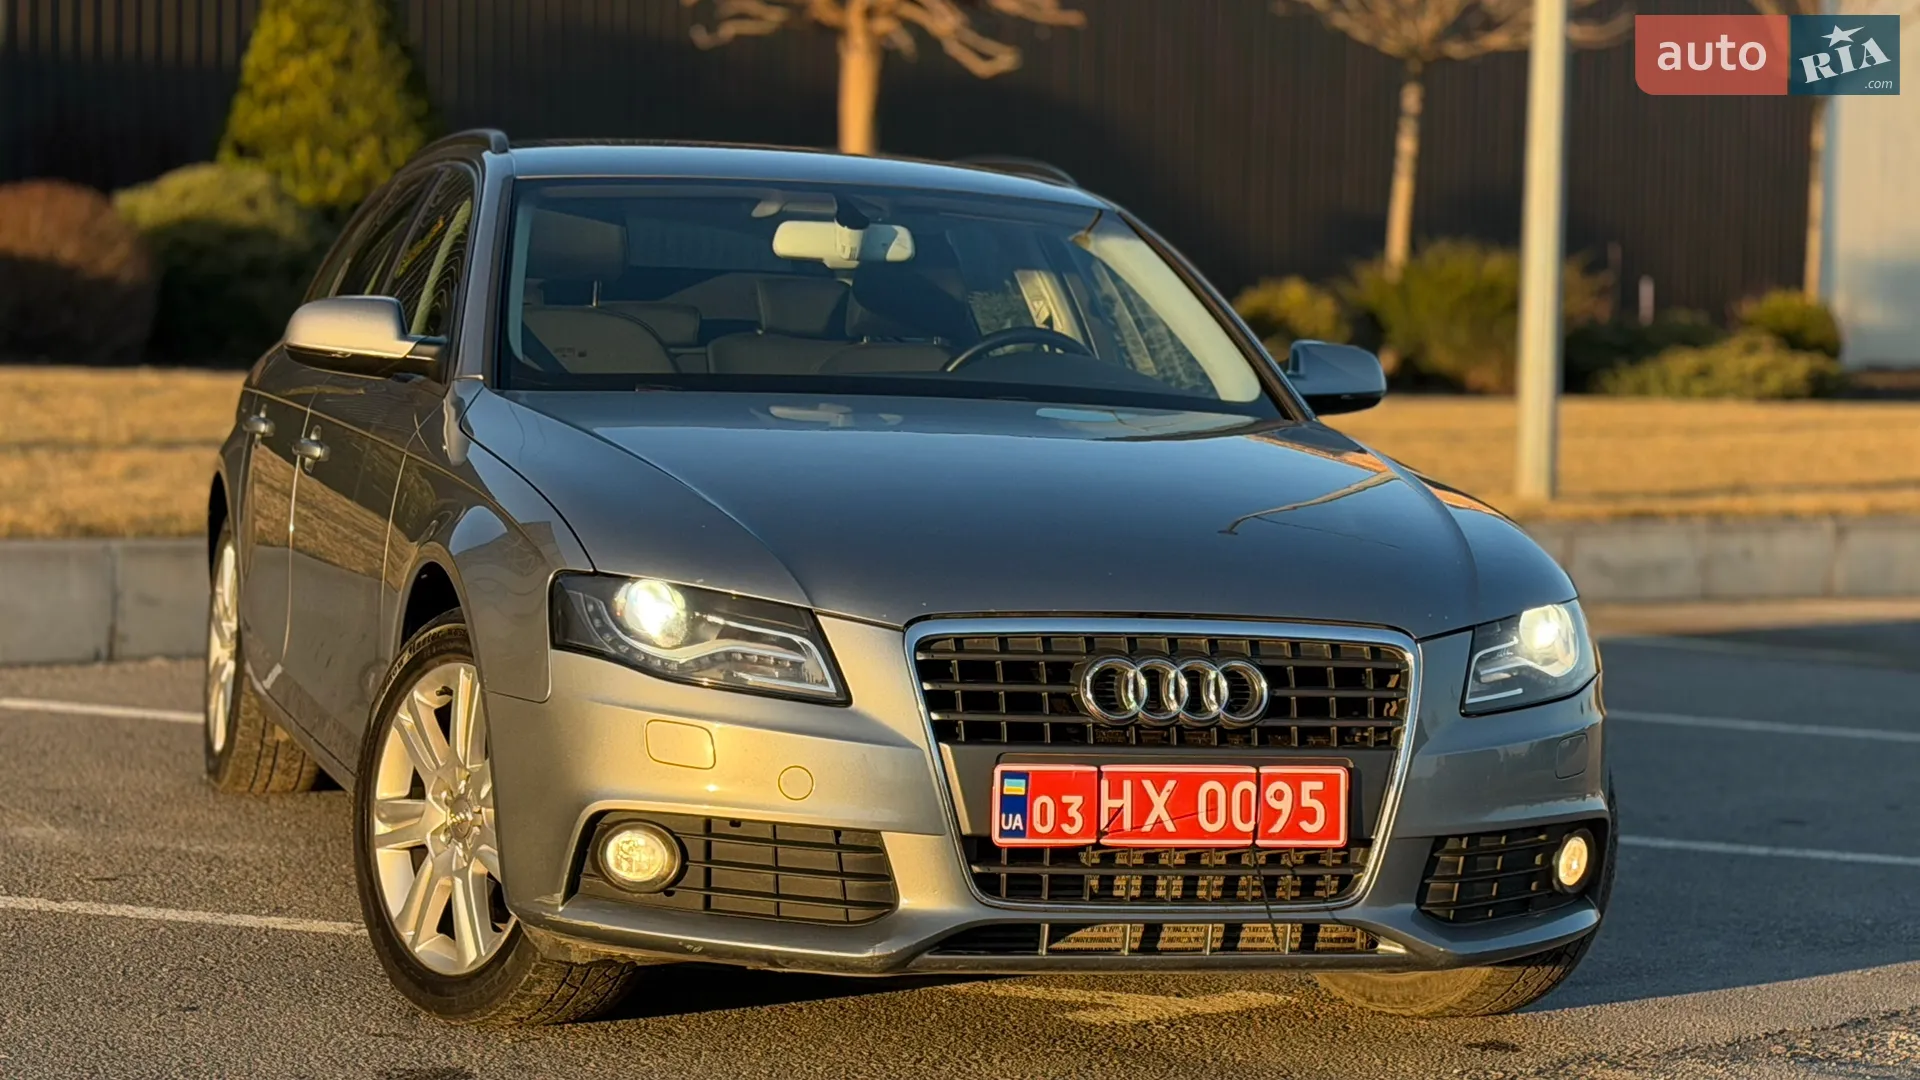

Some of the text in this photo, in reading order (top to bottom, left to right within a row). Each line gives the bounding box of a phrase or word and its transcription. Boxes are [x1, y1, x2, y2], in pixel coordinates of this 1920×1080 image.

[1001, 813, 1023, 831] UA
[1033, 779, 1326, 835] 03 HX 0095
